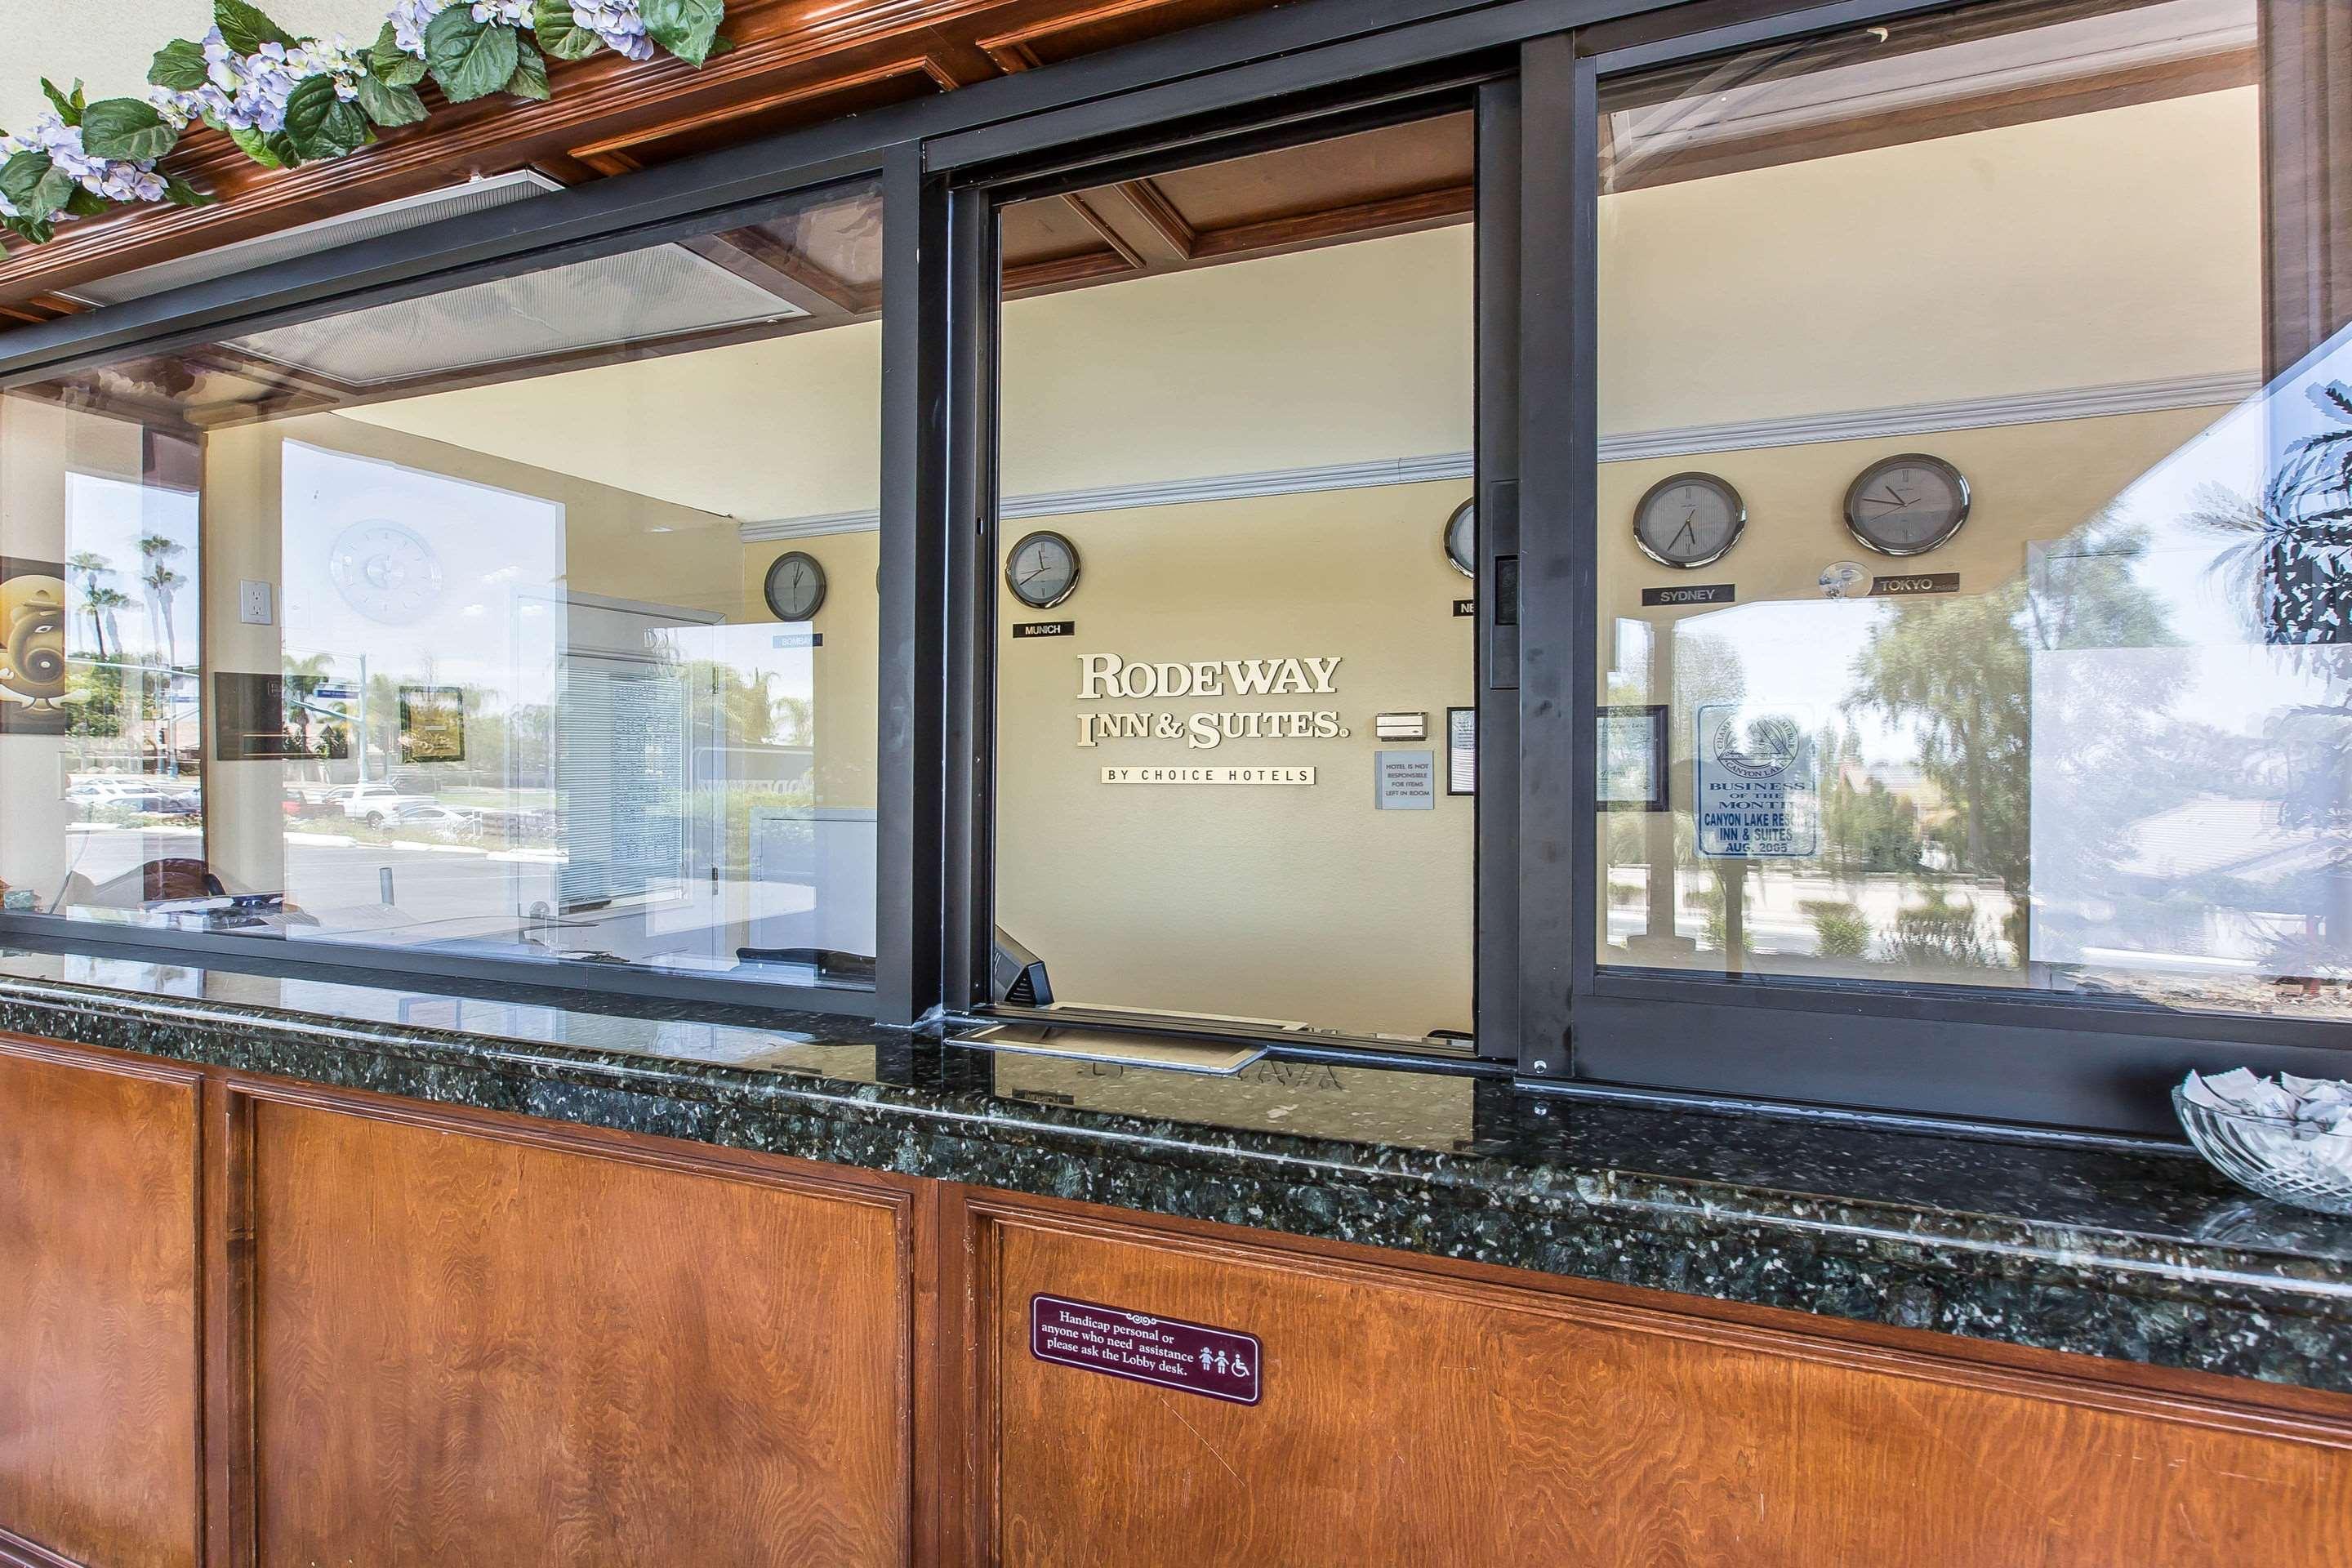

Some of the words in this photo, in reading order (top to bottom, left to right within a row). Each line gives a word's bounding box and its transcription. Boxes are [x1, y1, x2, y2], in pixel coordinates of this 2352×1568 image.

[1880, 579, 1933, 591] TOKYO
[1660, 589, 1715, 602] SYDNEY
[1025, 625, 1061, 635] MUNICH
[1076, 653, 1343, 699] RODEWAY
[1108, 770, 1129, 781] BY
[1141, 770, 1214, 781] CHOICE
[1228, 770, 1308, 781] HOTELS
[1726, 761, 1762, 777] CANYON
[1709, 782, 1806, 791] BUSINESS
[1704, 813, 1741, 826] CANYON
[1744, 813, 1769, 826] LAKE
[1720, 828, 1738, 840] INN
[1742, 828, 1750, 840] &
[1754, 828, 1793, 841] SUITES
[1725, 843, 1754, 853] AUG.
[1058, 1310, 1111, 1333] Handicap
[1113, 1323, 1159, 1341] personal
[1161, 1334, 1174, 1344] or
[1041, 1322, 1080, 1339] anyone
[1081, 1330, 1104, 1344] who
[1107, 1338, 1133, 1350] need
[1138, 1343, 1194, 1363] assistance
[1047, 1337, 1079, 1353] please
[1081, 1345, 1099, 1357] ask
[1102, 1349, 1120, 1361] the
[1122, 1352, 1156, 1370] Lobby
[1158, 1360, 1188, 1377] desk.
